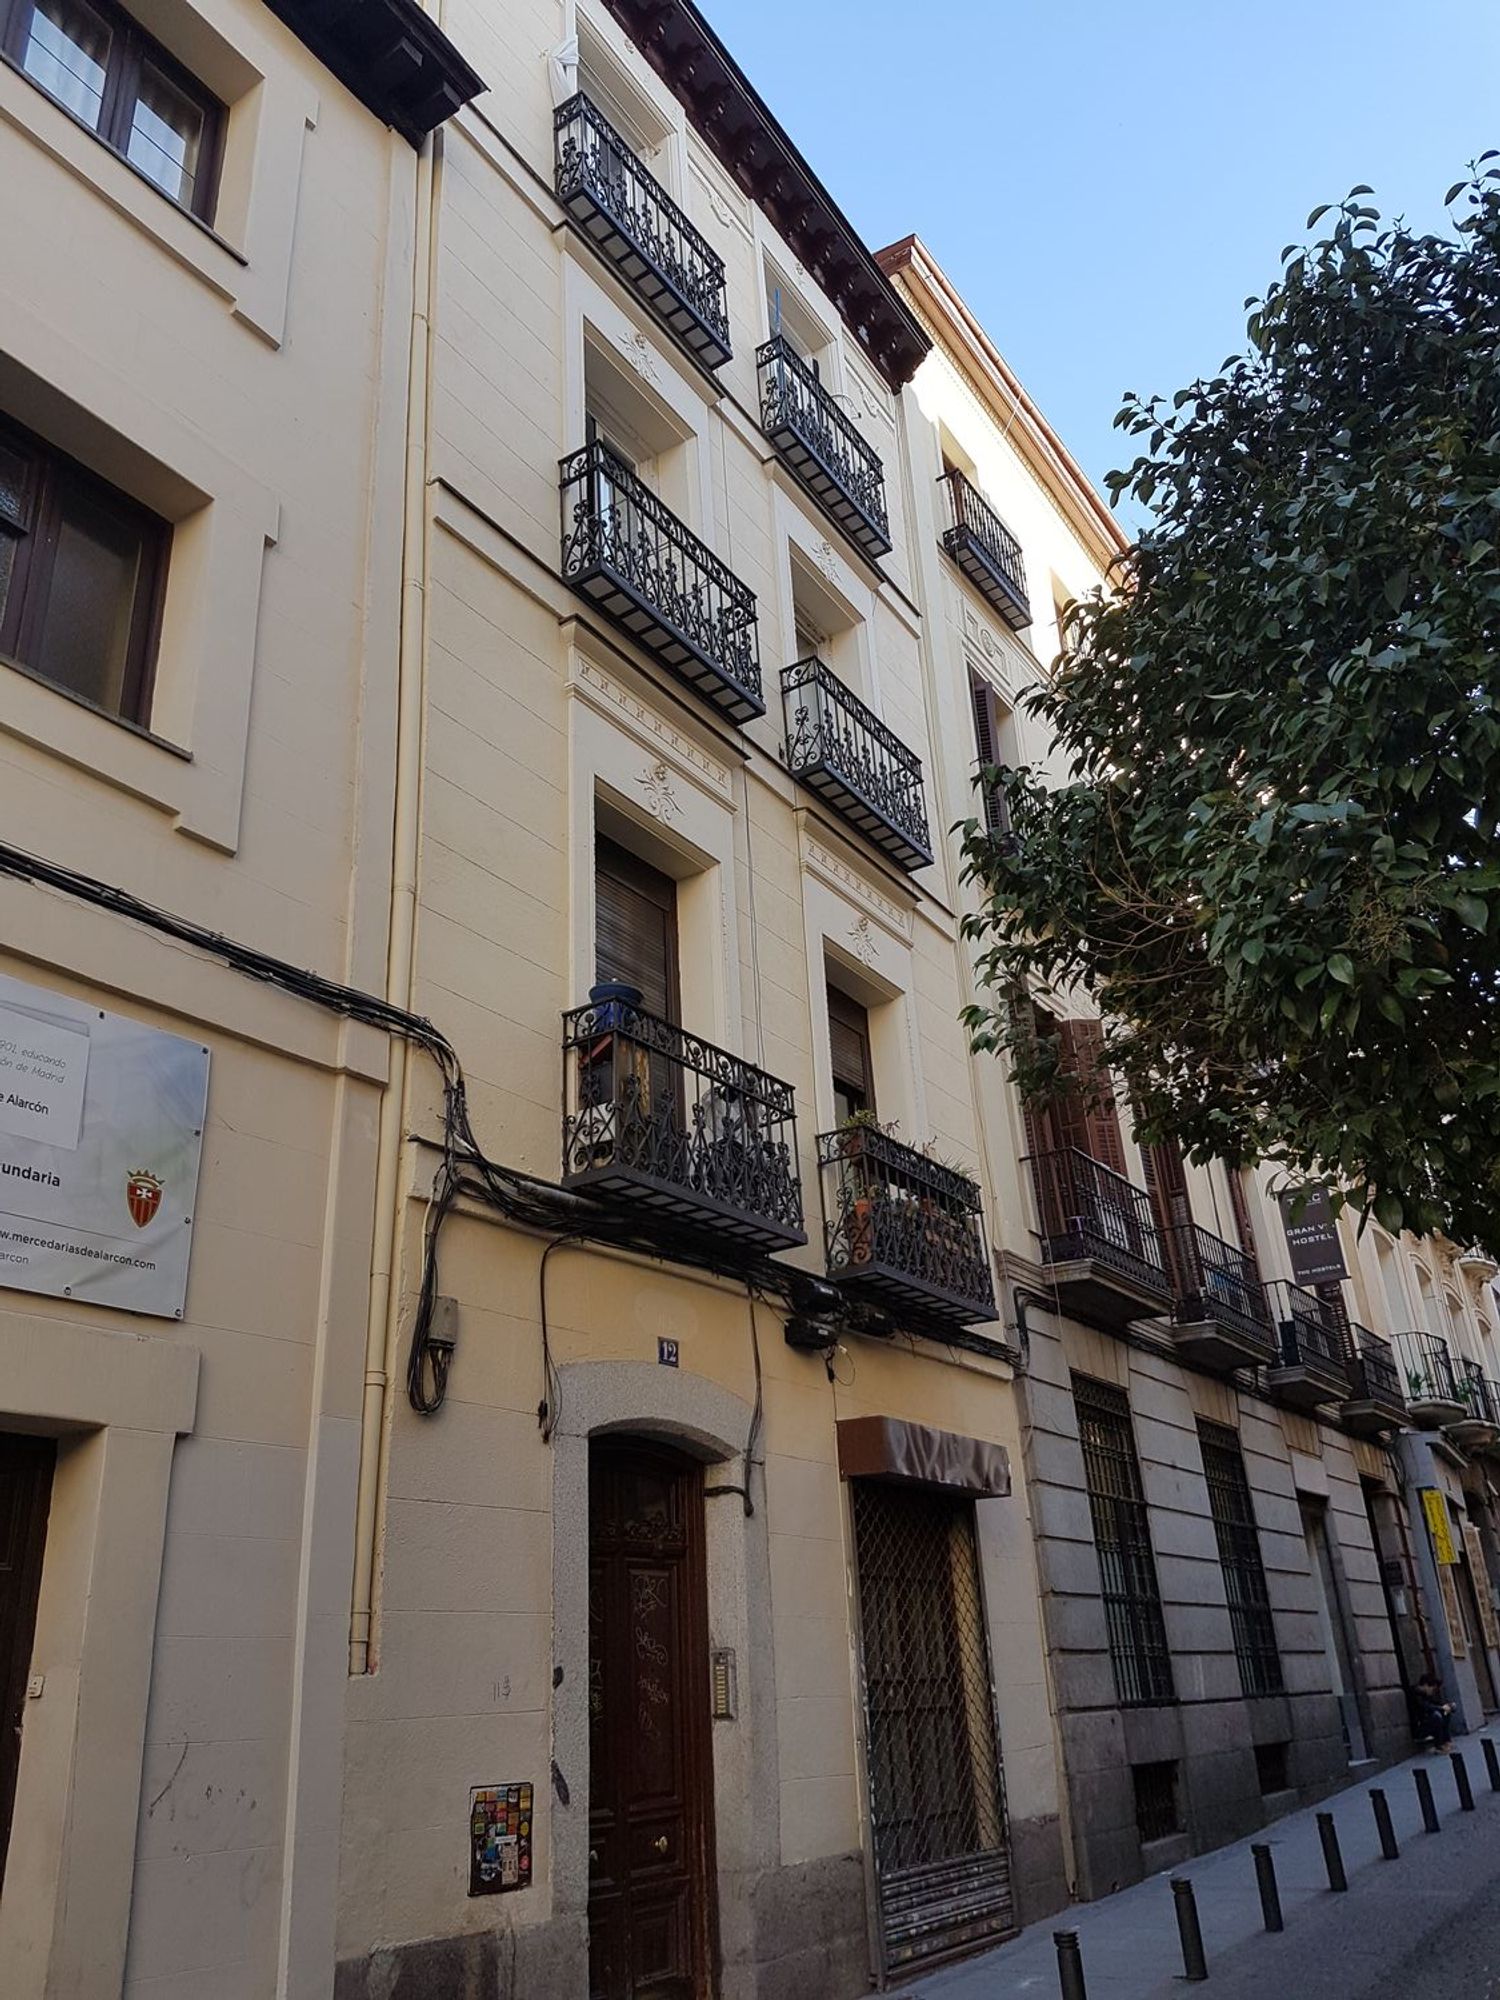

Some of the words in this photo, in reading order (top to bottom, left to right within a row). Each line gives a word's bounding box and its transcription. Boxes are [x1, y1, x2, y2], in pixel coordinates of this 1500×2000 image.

[22, 1049, 66, 1068] educando
[16, 1063, 28, 1072] de
[32, 1066, 65, 1083] Madrid
[7, 1094, 49, 1115] Alarcón
[0, 1163, 61, 1187] undaria
[1287, 1226, 1315, 1236] GRAN
[1292, 1233, 1334, 1246] HOSTEL
[663, 1341, 677, 1362] 12
